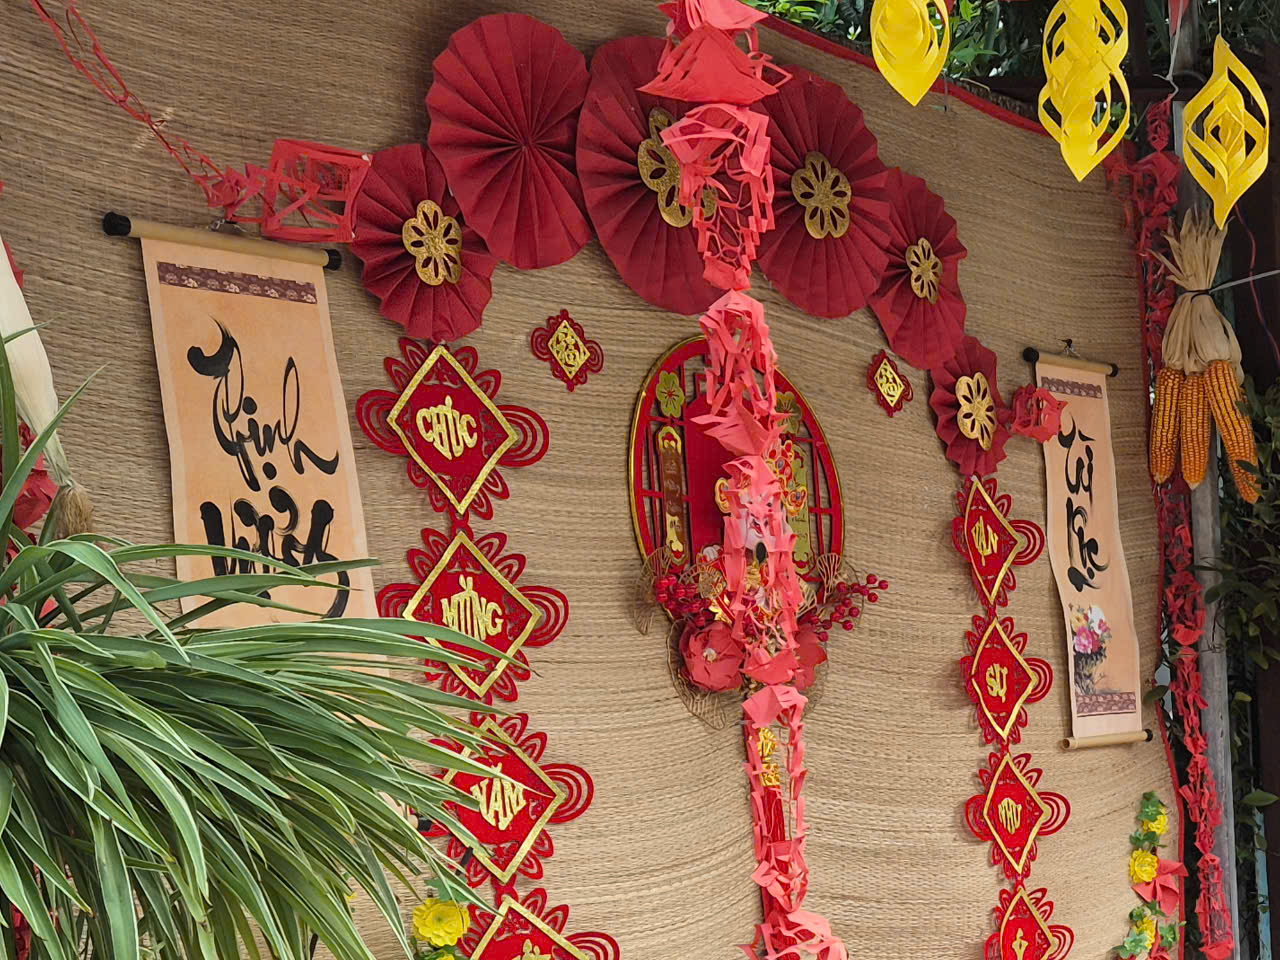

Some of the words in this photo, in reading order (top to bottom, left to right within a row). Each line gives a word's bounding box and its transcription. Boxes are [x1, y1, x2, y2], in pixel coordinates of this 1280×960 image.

[415, 395, 478, 461] CHÚC
[441, 574, 504, 642] MỪNG
[985, 663, 1009, 704] SỰ
[470, 762, 527, 831] NĂM
